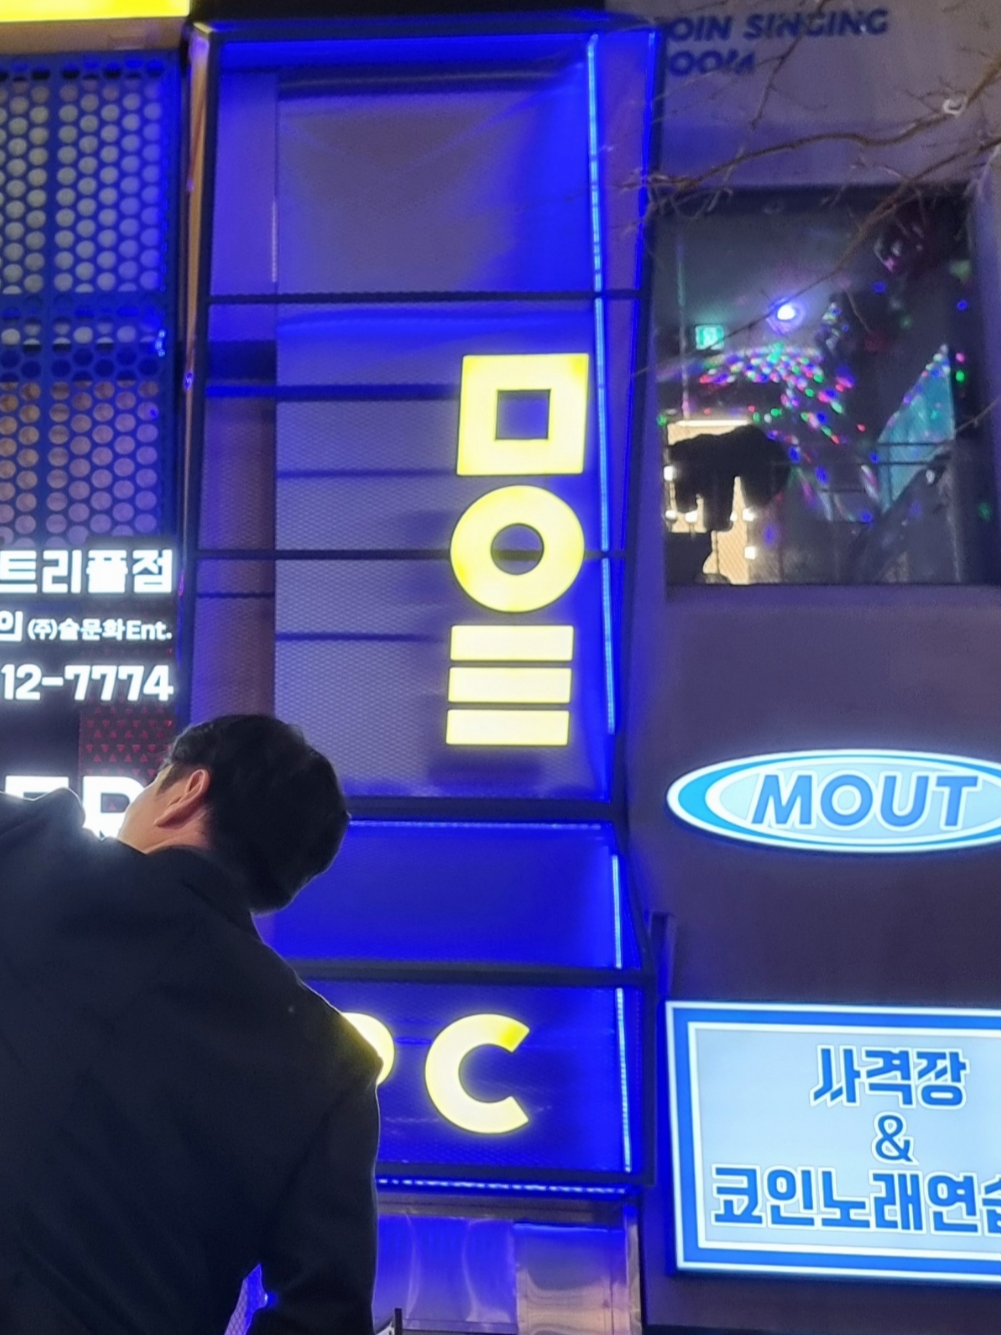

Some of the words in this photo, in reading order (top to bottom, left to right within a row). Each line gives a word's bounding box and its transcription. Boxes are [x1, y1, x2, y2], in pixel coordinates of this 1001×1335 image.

[743, 8, 889, 39] SINGING
[750, 773, 980, 829] MOUT
[811, 1046, 968, 1109] 사격장
[874, 1113, 916, 1163] &
